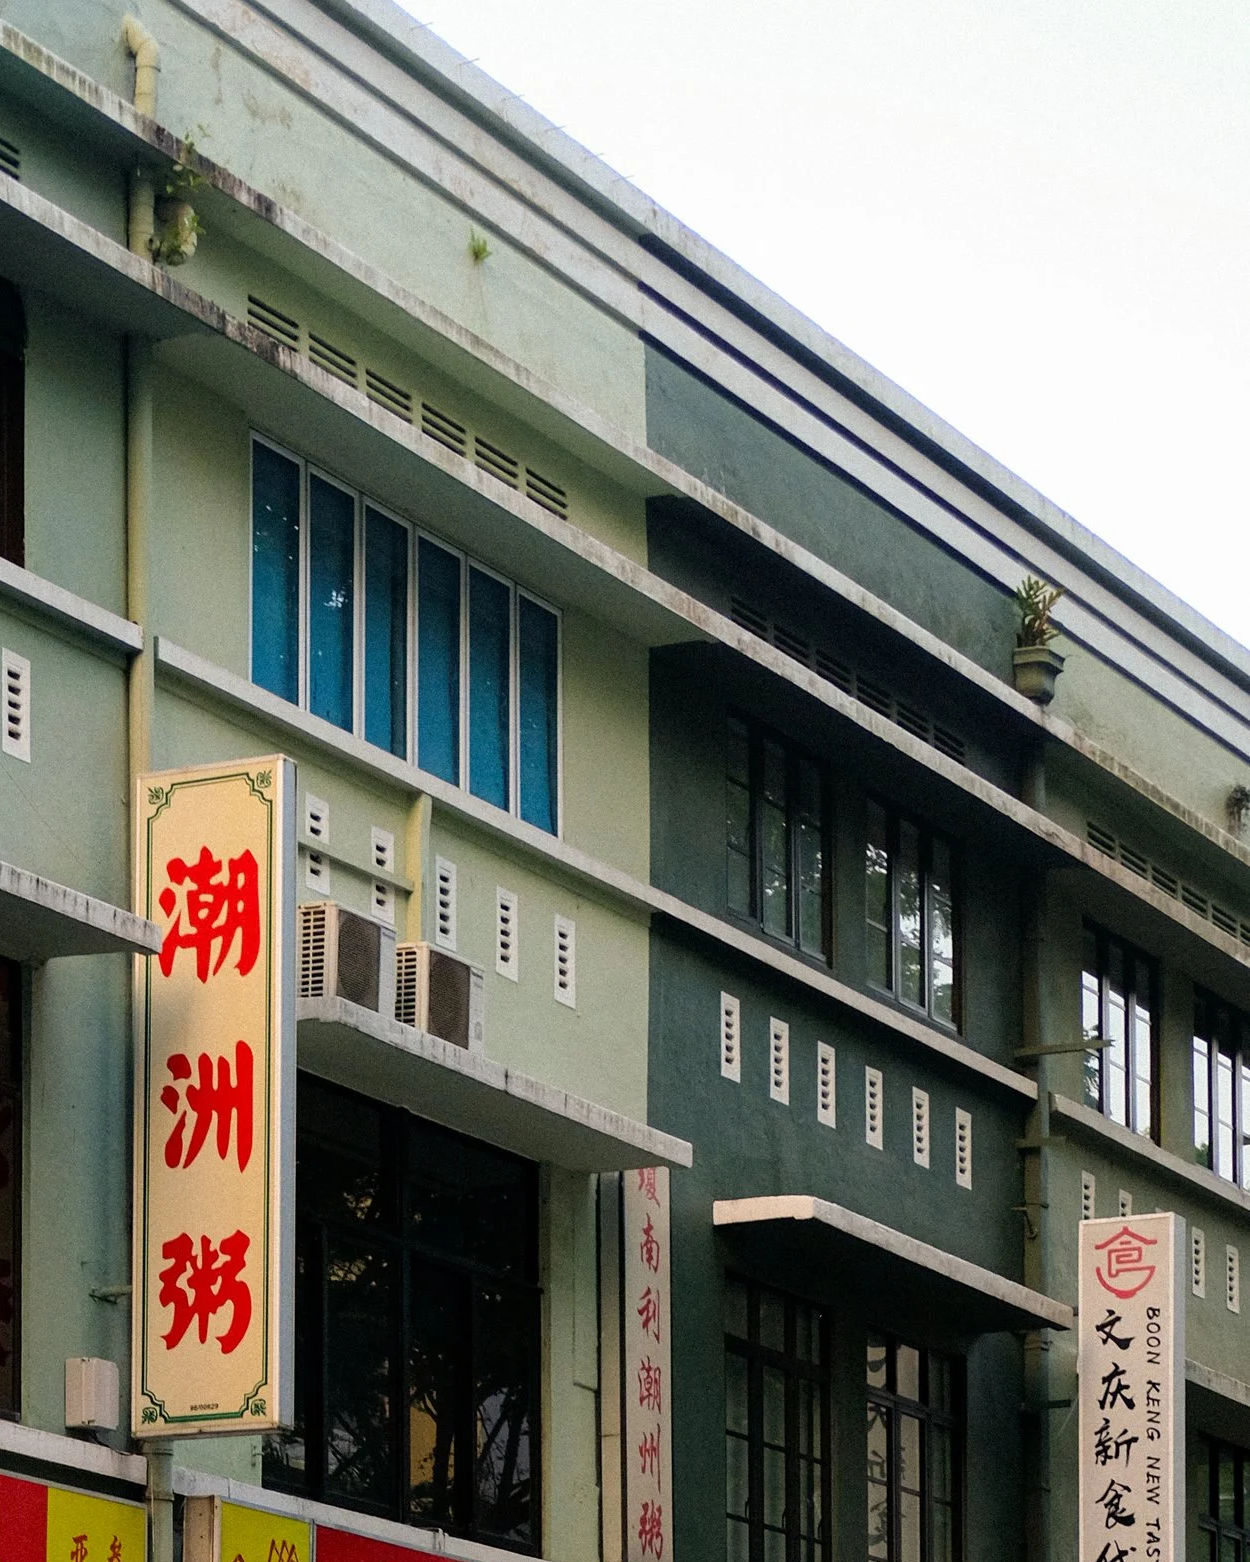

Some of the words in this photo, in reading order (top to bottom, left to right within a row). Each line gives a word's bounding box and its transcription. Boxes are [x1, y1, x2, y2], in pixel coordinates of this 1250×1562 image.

[158, 845, 261, 1354] 潮洲粥
[1146, 1306, 1161, 1365] BOON
[1146, 1379, 1161, 1442] KENG
[1145, 1456, 1161, 1505] NEW
